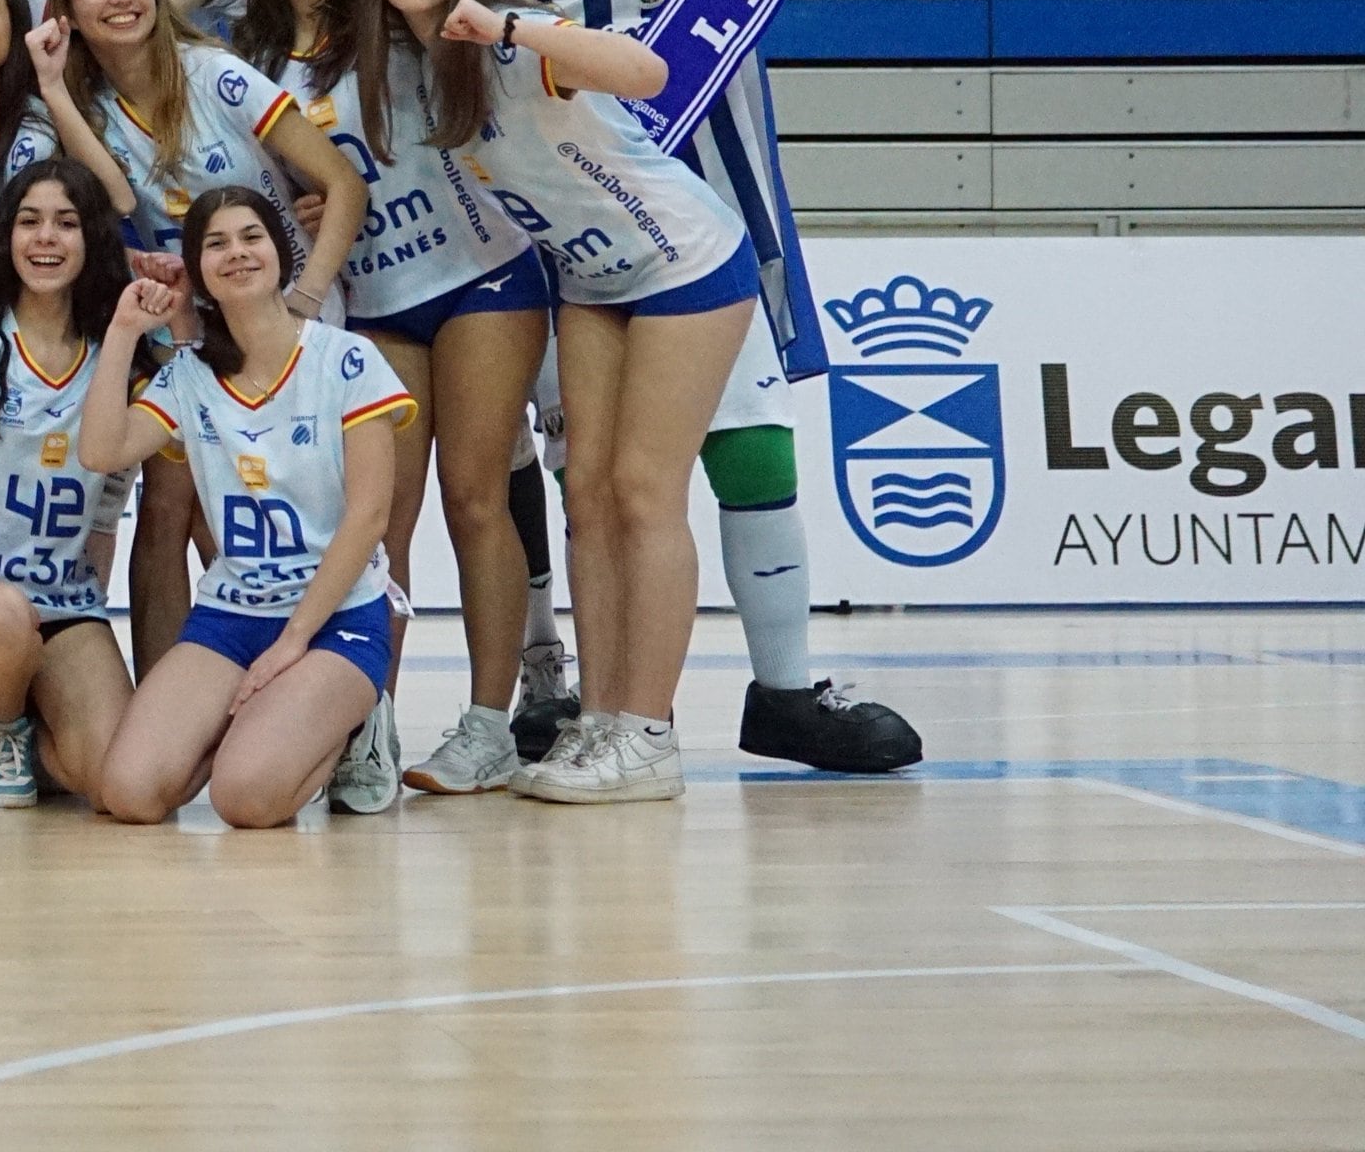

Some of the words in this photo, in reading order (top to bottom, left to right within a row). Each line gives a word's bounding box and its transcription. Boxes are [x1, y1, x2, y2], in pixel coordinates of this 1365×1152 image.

[556, 141, 681, 264] @voleibolleganes
[347, 226, 448, 277] EGANÉS
[1040, 362, 1365, 498] Lega
[4, 473, 86, 538] 42
